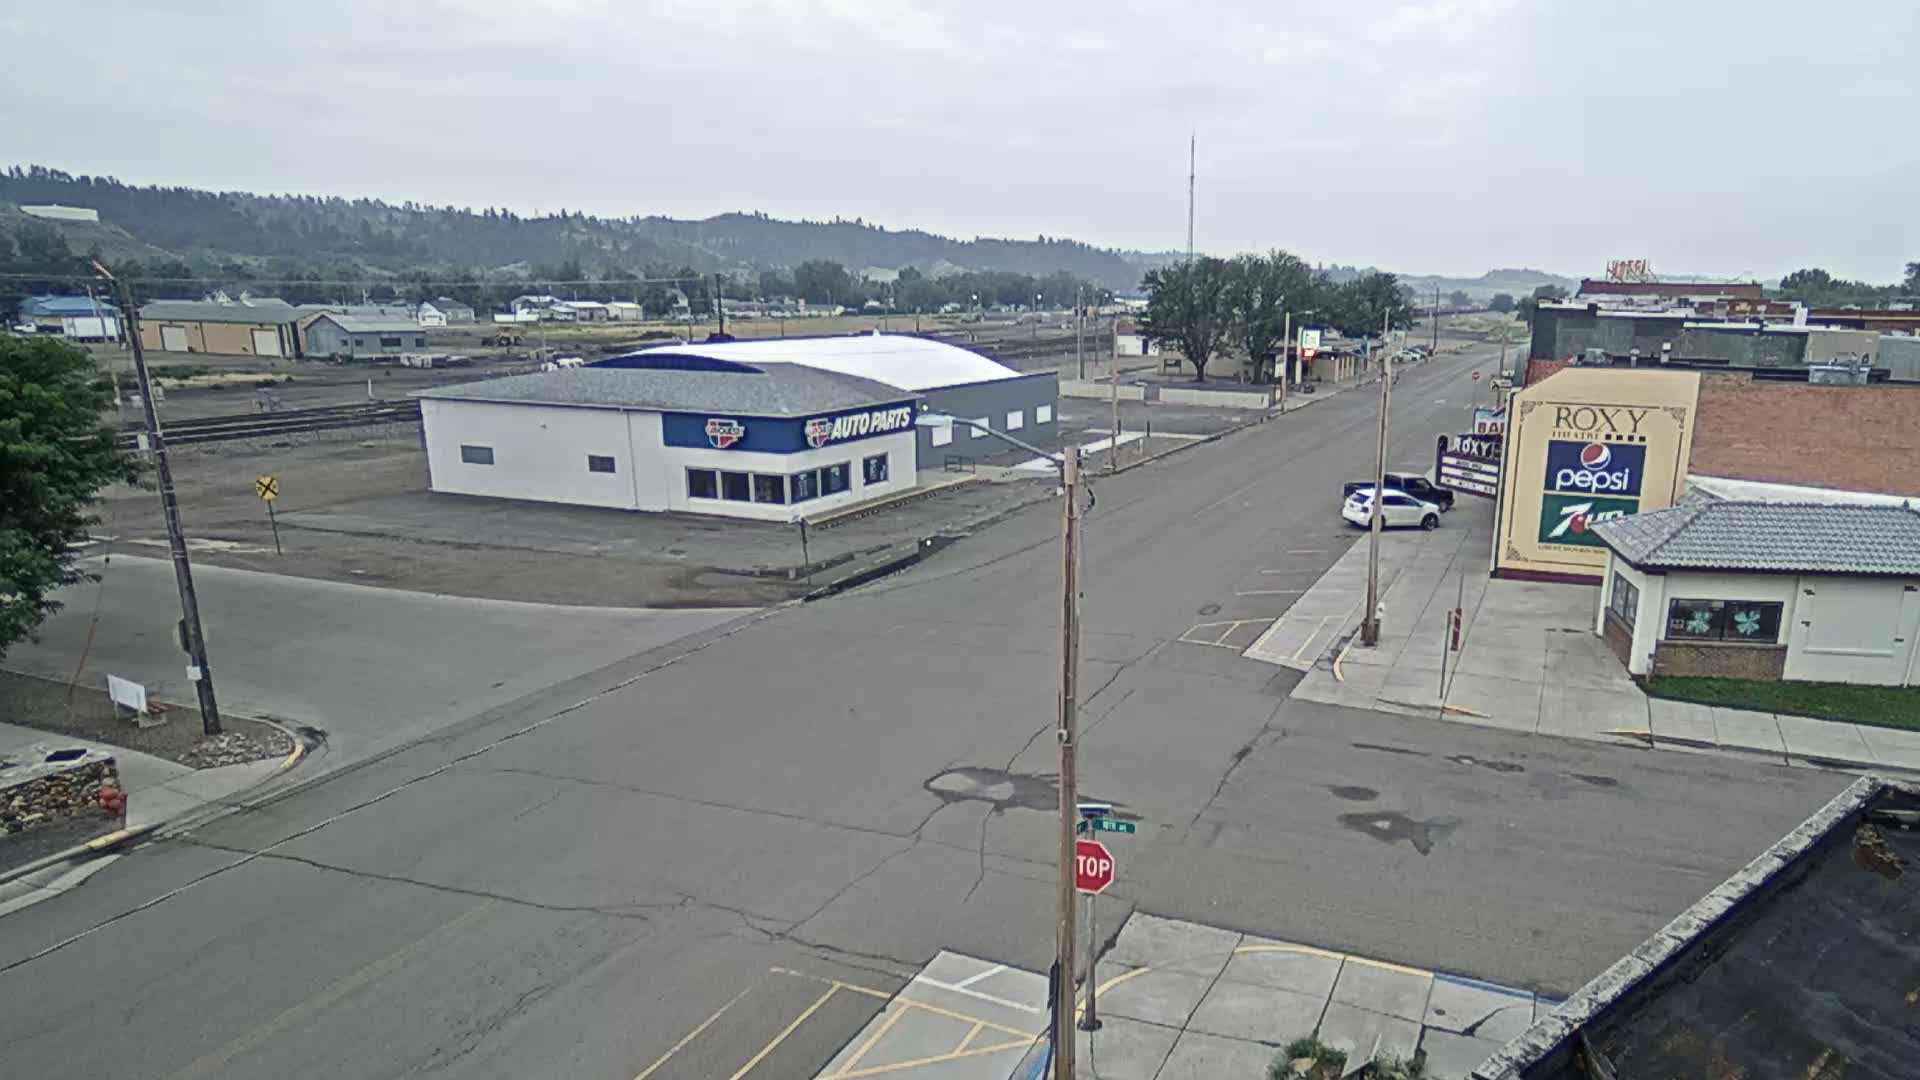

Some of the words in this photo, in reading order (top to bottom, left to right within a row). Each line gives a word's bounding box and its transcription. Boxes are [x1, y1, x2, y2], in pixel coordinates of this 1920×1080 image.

[831, 412, 869, 439] AUTO
[869, 407, 911, 433] PARTS
[1552, 407, 1648, 433] ROXY
[1453, 437, 1489, 457] ROXY
[1556, 467, 1629, 493] pepsi
[1077, 855, 1110, 878] TOP
